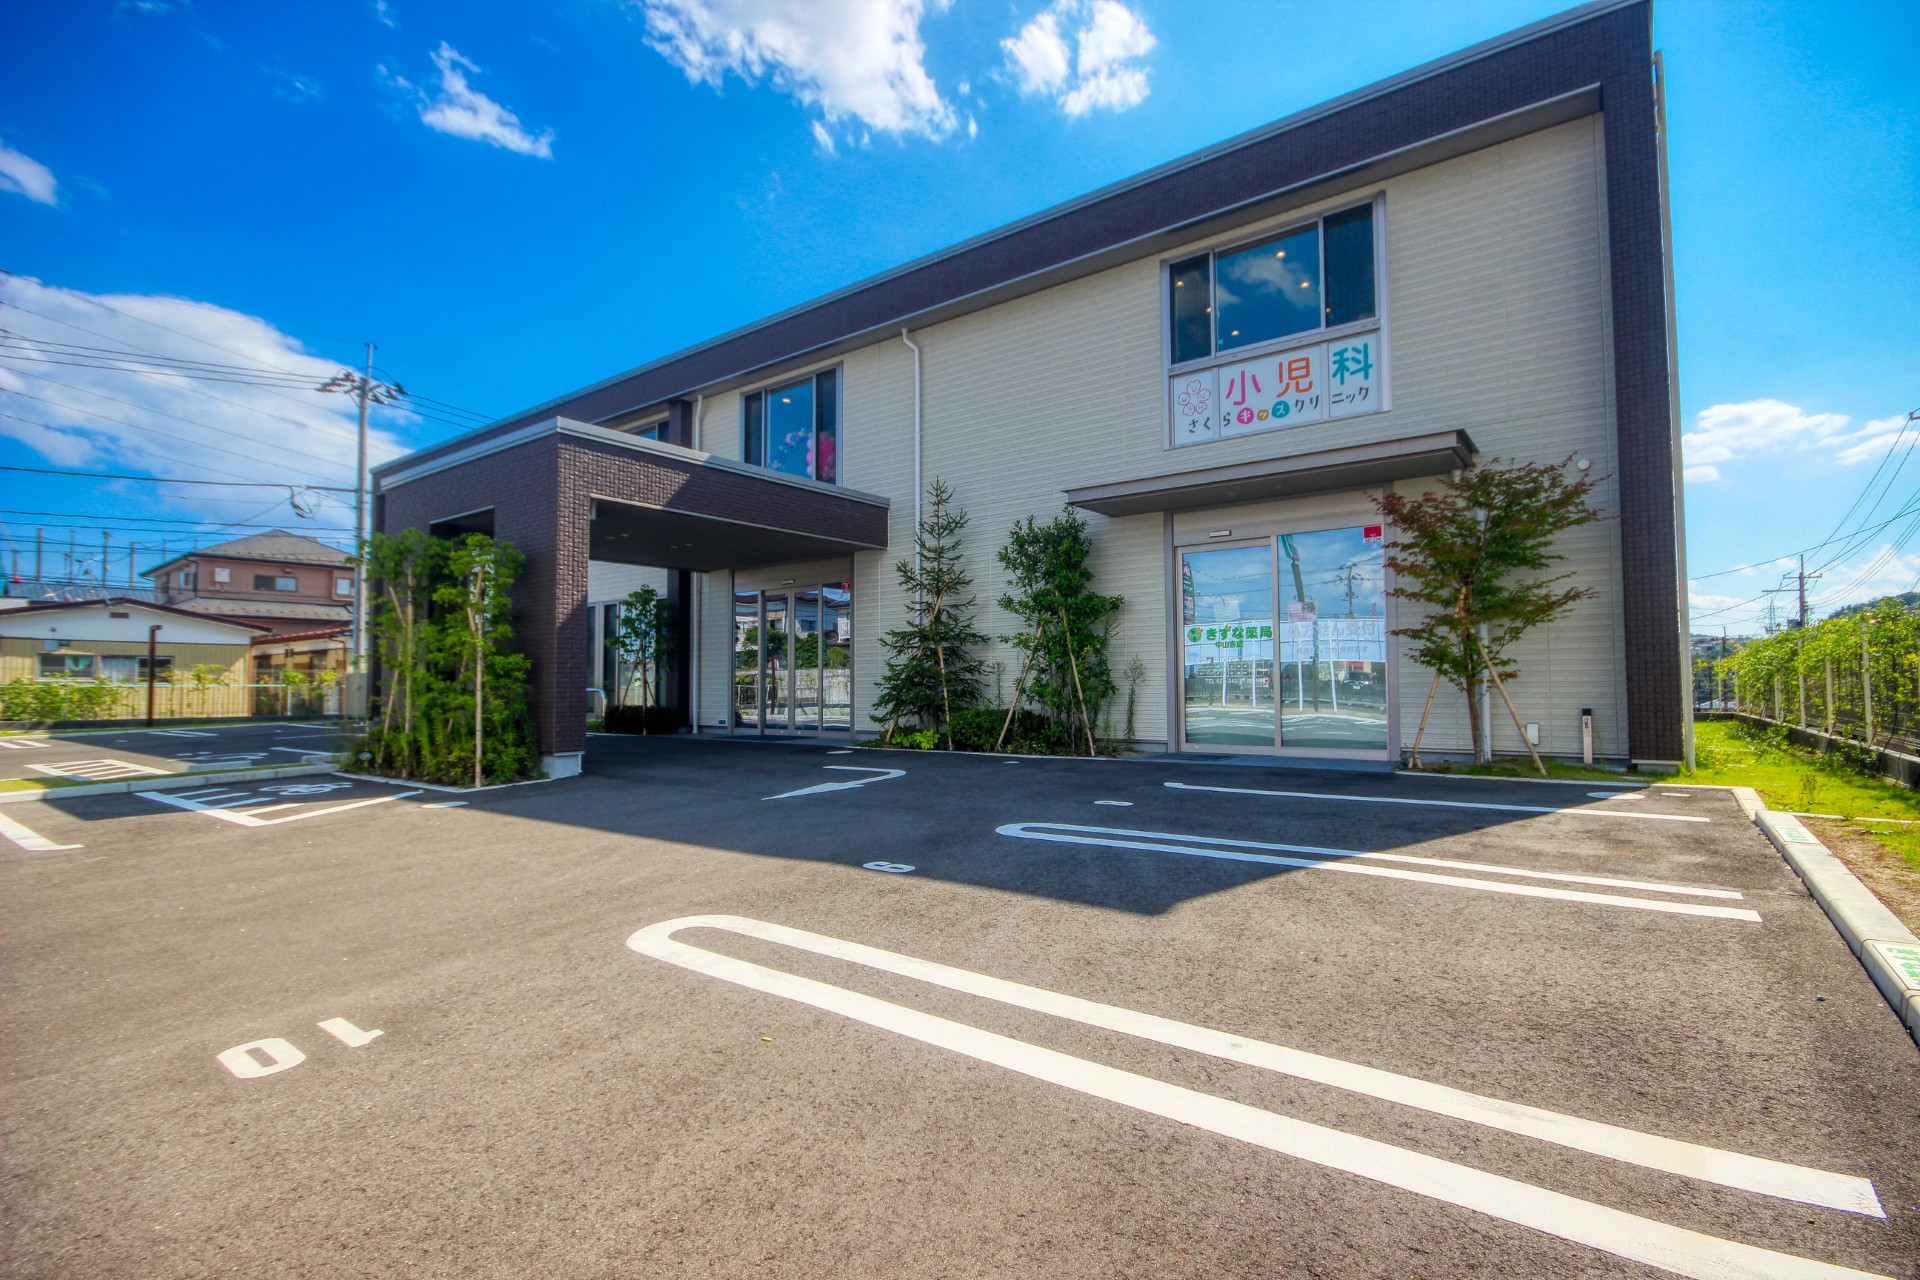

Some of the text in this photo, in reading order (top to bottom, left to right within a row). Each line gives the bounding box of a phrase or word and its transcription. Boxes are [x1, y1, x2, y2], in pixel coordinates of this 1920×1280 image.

[1226, 343, 1373, 405] 小児科
[1206, 625, 1272, 641] きずな薬局
[217, 1017, 384, 1079] 10
